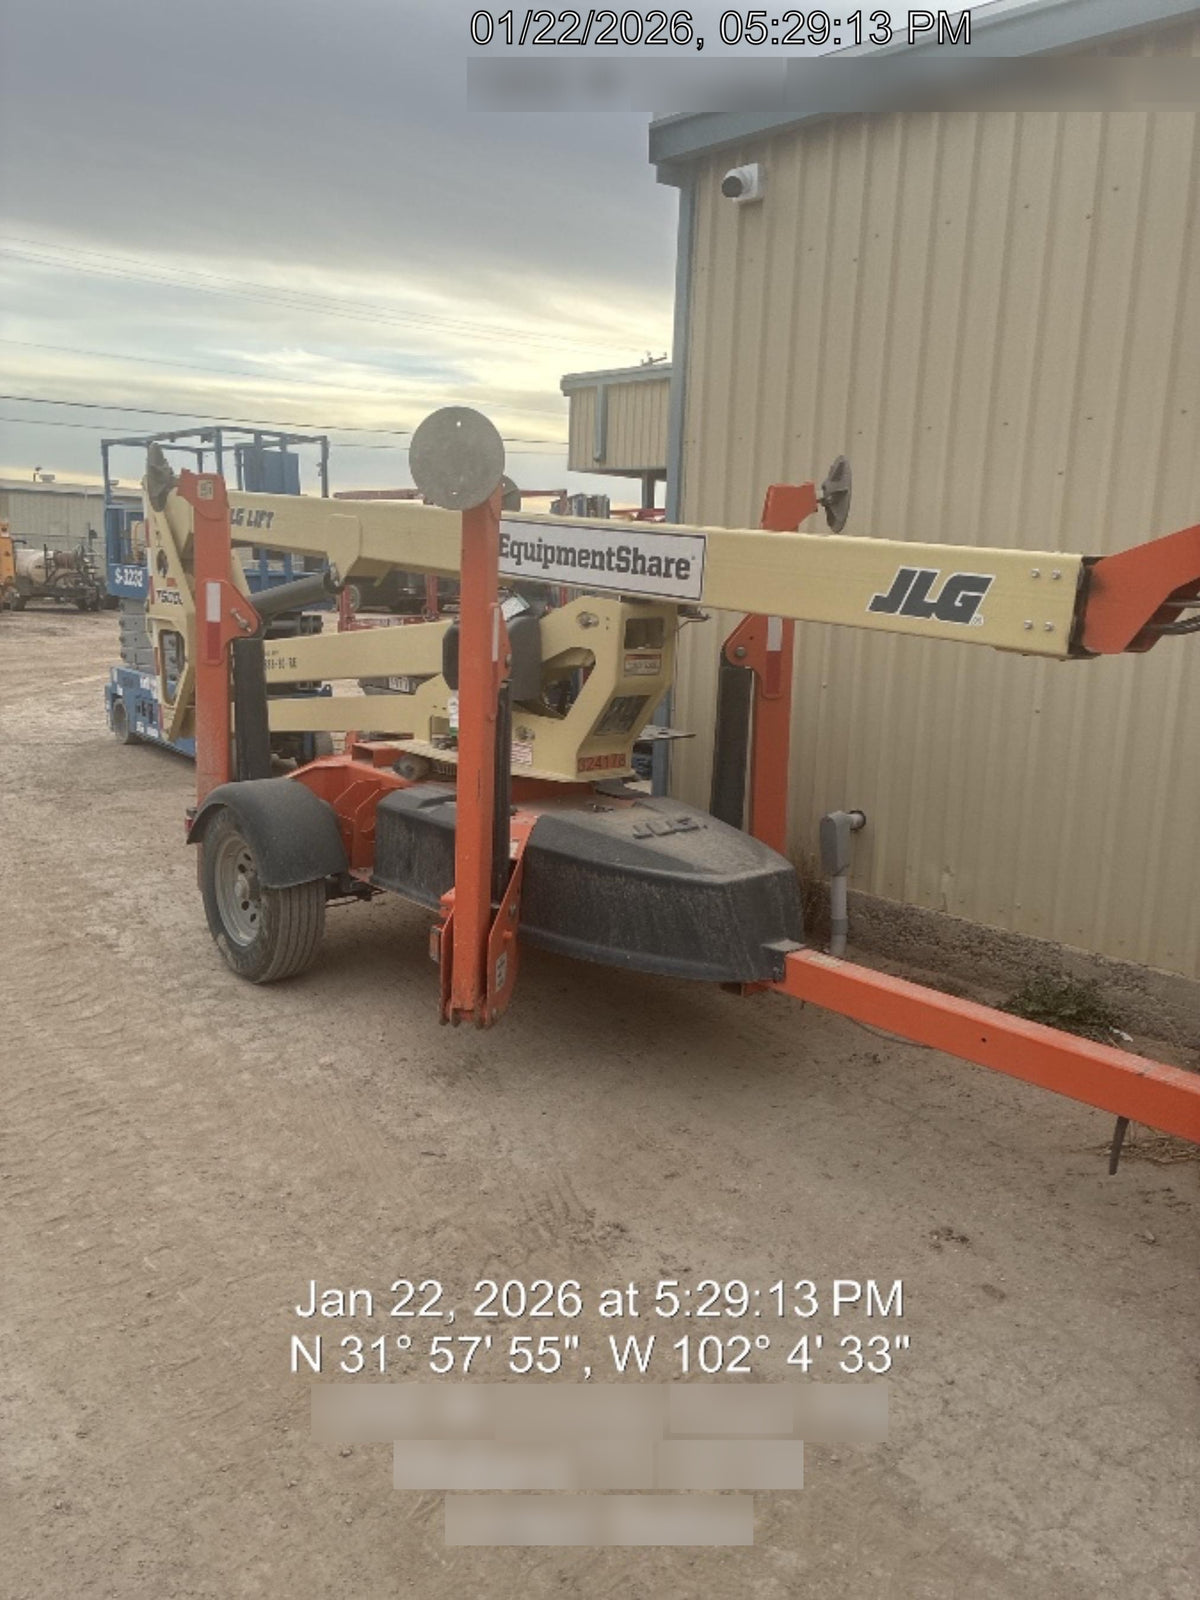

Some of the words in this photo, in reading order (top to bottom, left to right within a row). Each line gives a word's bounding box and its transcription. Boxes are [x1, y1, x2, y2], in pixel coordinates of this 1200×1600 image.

[230, 507, 245, 526] LG
[499, 533, 691, 580] EquipmentShare
[867, 567, 994, 625] JLG
